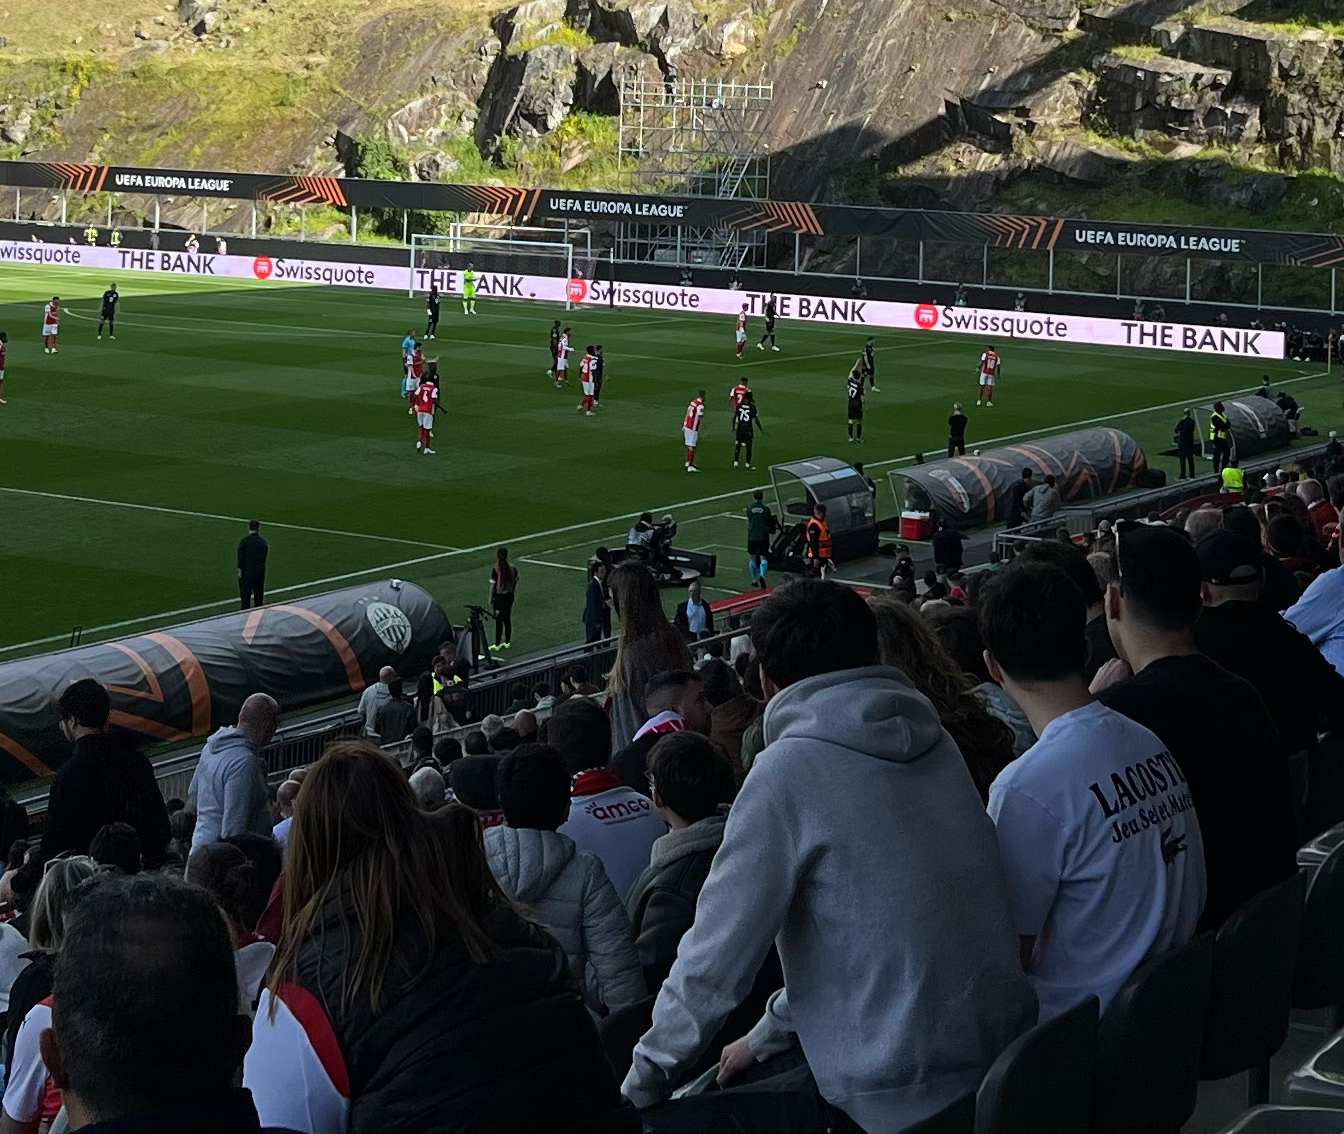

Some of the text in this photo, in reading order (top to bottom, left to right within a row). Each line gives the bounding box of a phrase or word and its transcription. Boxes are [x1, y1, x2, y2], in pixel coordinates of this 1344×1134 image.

[115, 174, 230, 191] UEFA EUROPA LEAGUE
[549, 198, 684, 217] UEFA EUROPA LEAGUE
[1075, 229, 1240, 252] UEFA EUROPA LEAGUE
[118, 250, 216, 274] THE BANK
[275, 258, 375, 286] Swissquote
[416, 270, 524, 297] THE ANK
[590, 279, 700, 308] Swissquote
[799, 298, 866, 322] BANK
[942, 305, 1068, 337] Swissquote
[1121, 321, 1261, 355] THE BANK
[739, 408, 750, 422] 75
[1112, 819, 1140, 844] Jeu
